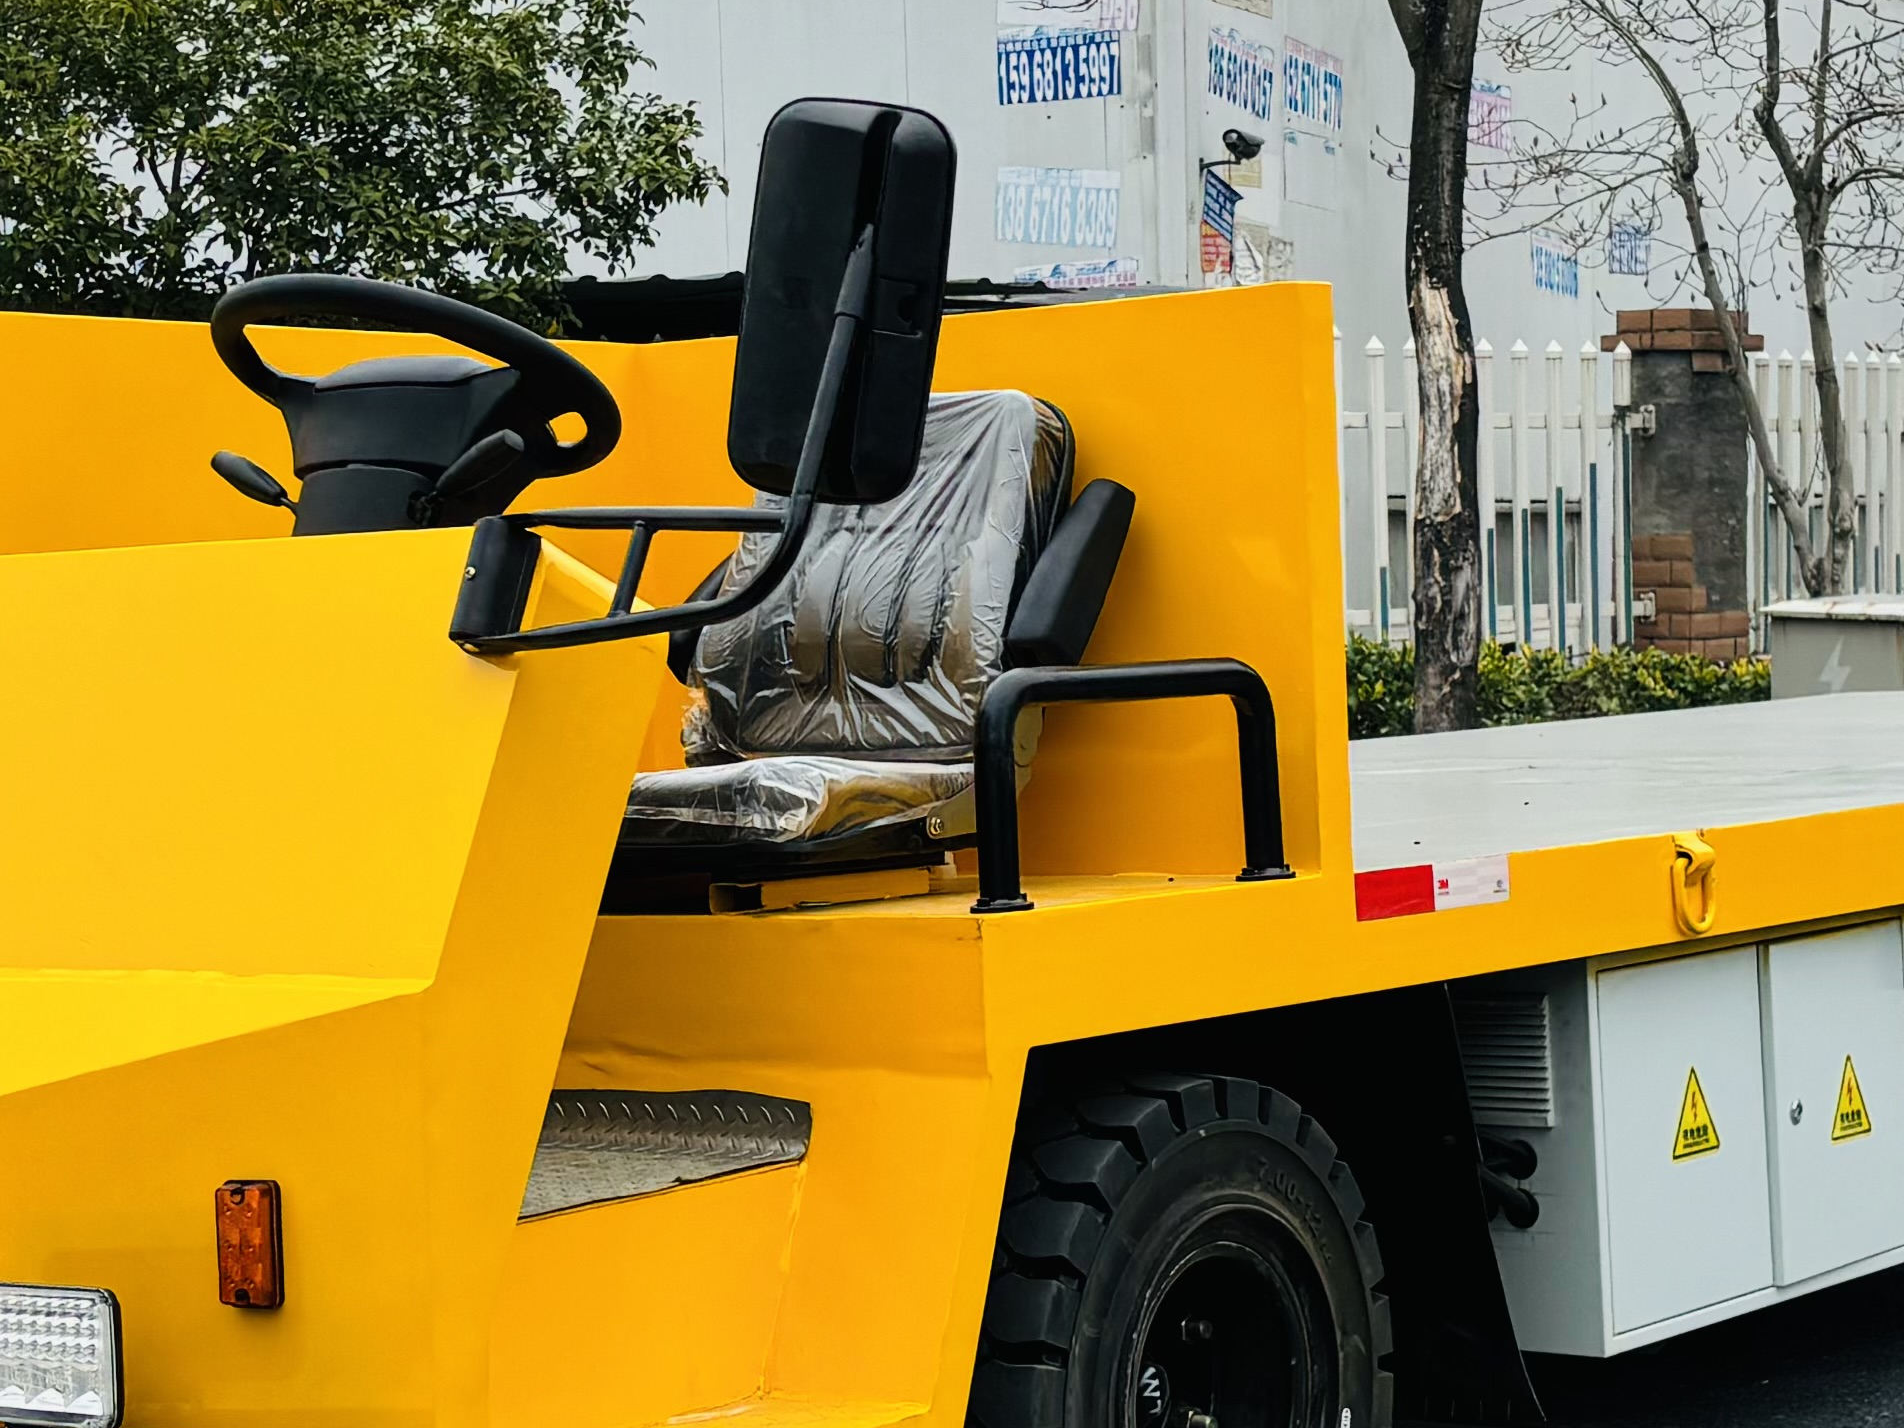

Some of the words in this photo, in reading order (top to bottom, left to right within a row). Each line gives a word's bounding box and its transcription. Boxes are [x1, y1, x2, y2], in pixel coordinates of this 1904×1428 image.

[999, 50, 1031, 105] 159
[1033, 46, 1076, 102] 6813
[1078, 41, 1120, 99] 5997
[996, 183, 1026, 242] 138
